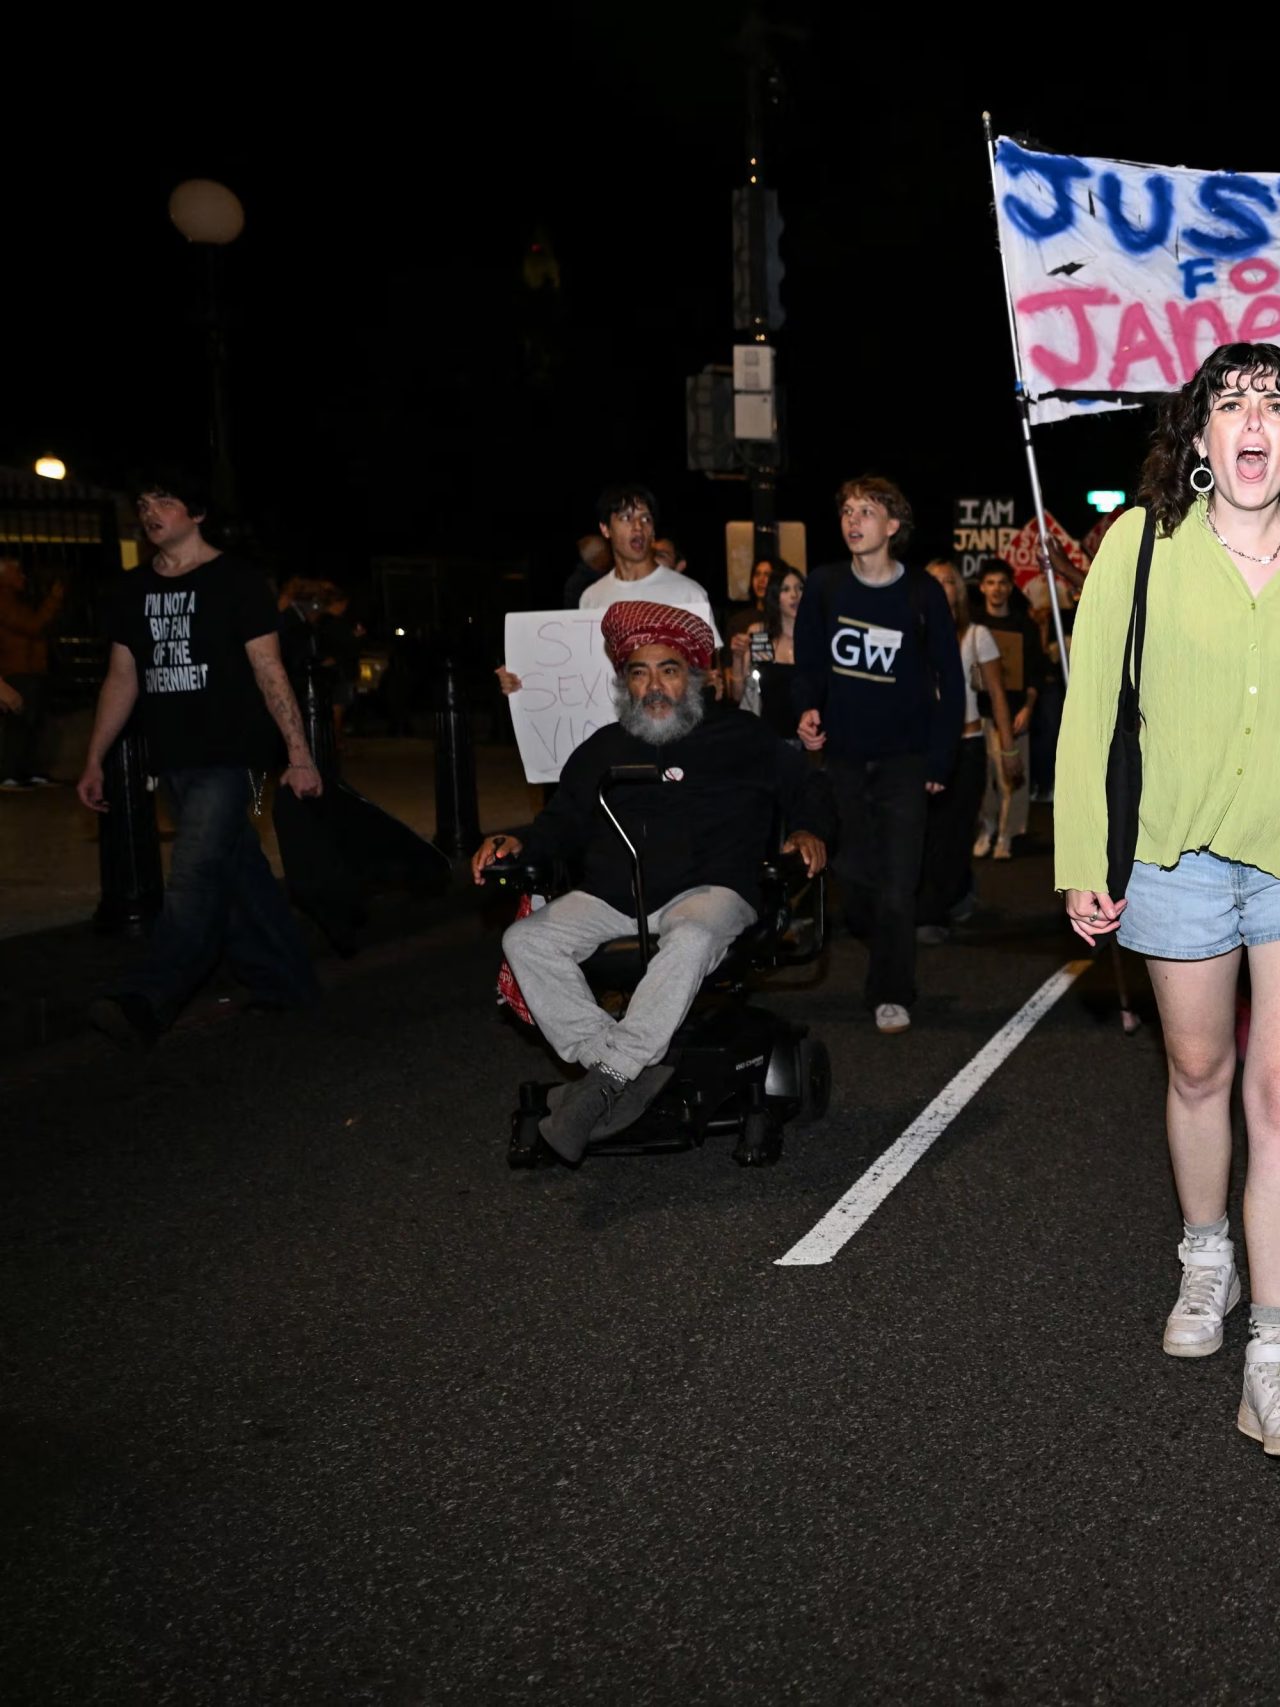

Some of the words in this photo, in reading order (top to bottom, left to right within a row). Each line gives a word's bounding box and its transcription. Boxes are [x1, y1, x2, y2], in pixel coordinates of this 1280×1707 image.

[959, 500, 979, 526] I
[980, 499, 1015, 526] AM
[953, 528, 1020, 552] JANE
[144, 592, 161, 616] I'M
[164, 591, 187, 616] NOT
[186, 590, 195, 614] A
[149, 616, 170, 641] BIG
[171, 615, 190, 640] FAN
[153, 641, 166, 667] OF
[168, 640, 192, 665] THE
[831, 627, 898, 674] GW
